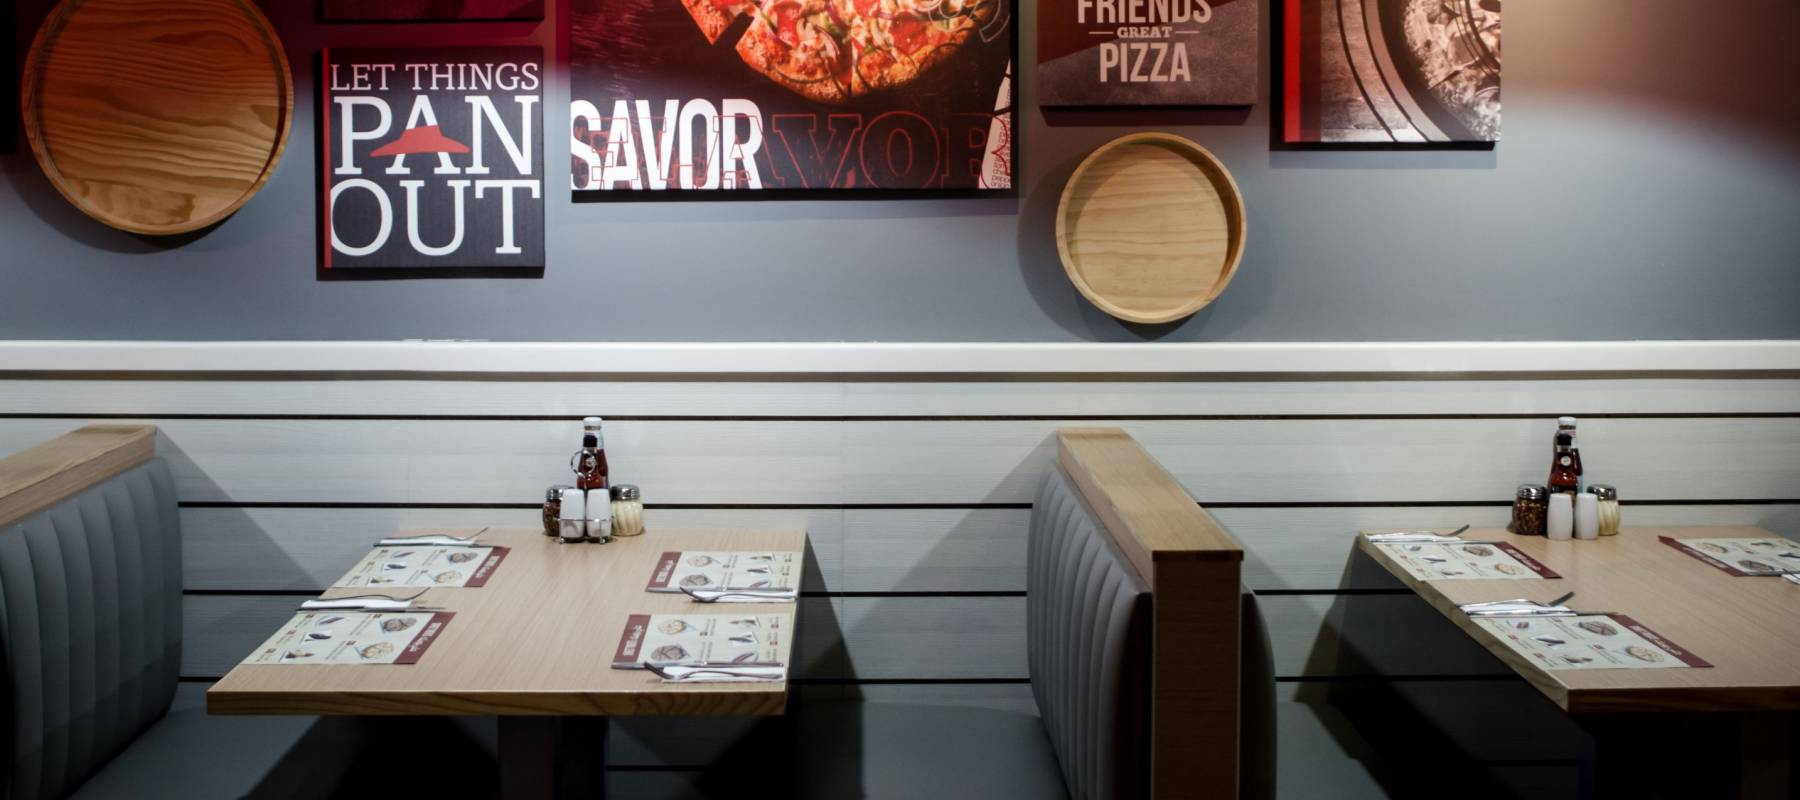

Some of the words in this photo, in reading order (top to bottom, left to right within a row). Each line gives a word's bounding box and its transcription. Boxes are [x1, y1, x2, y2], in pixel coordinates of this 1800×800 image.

[1100, 42, 1191, 82] PIZZA
[1116, 26, 1173, 39] GREAT
[330, 64, 395, 91] LET
[405, 63, 539, 91] THINGS
[333, 95, 539, 175] PAN
[571, 98, 763, 190] SAVOR
[330, 178, 541, 257] OUT
